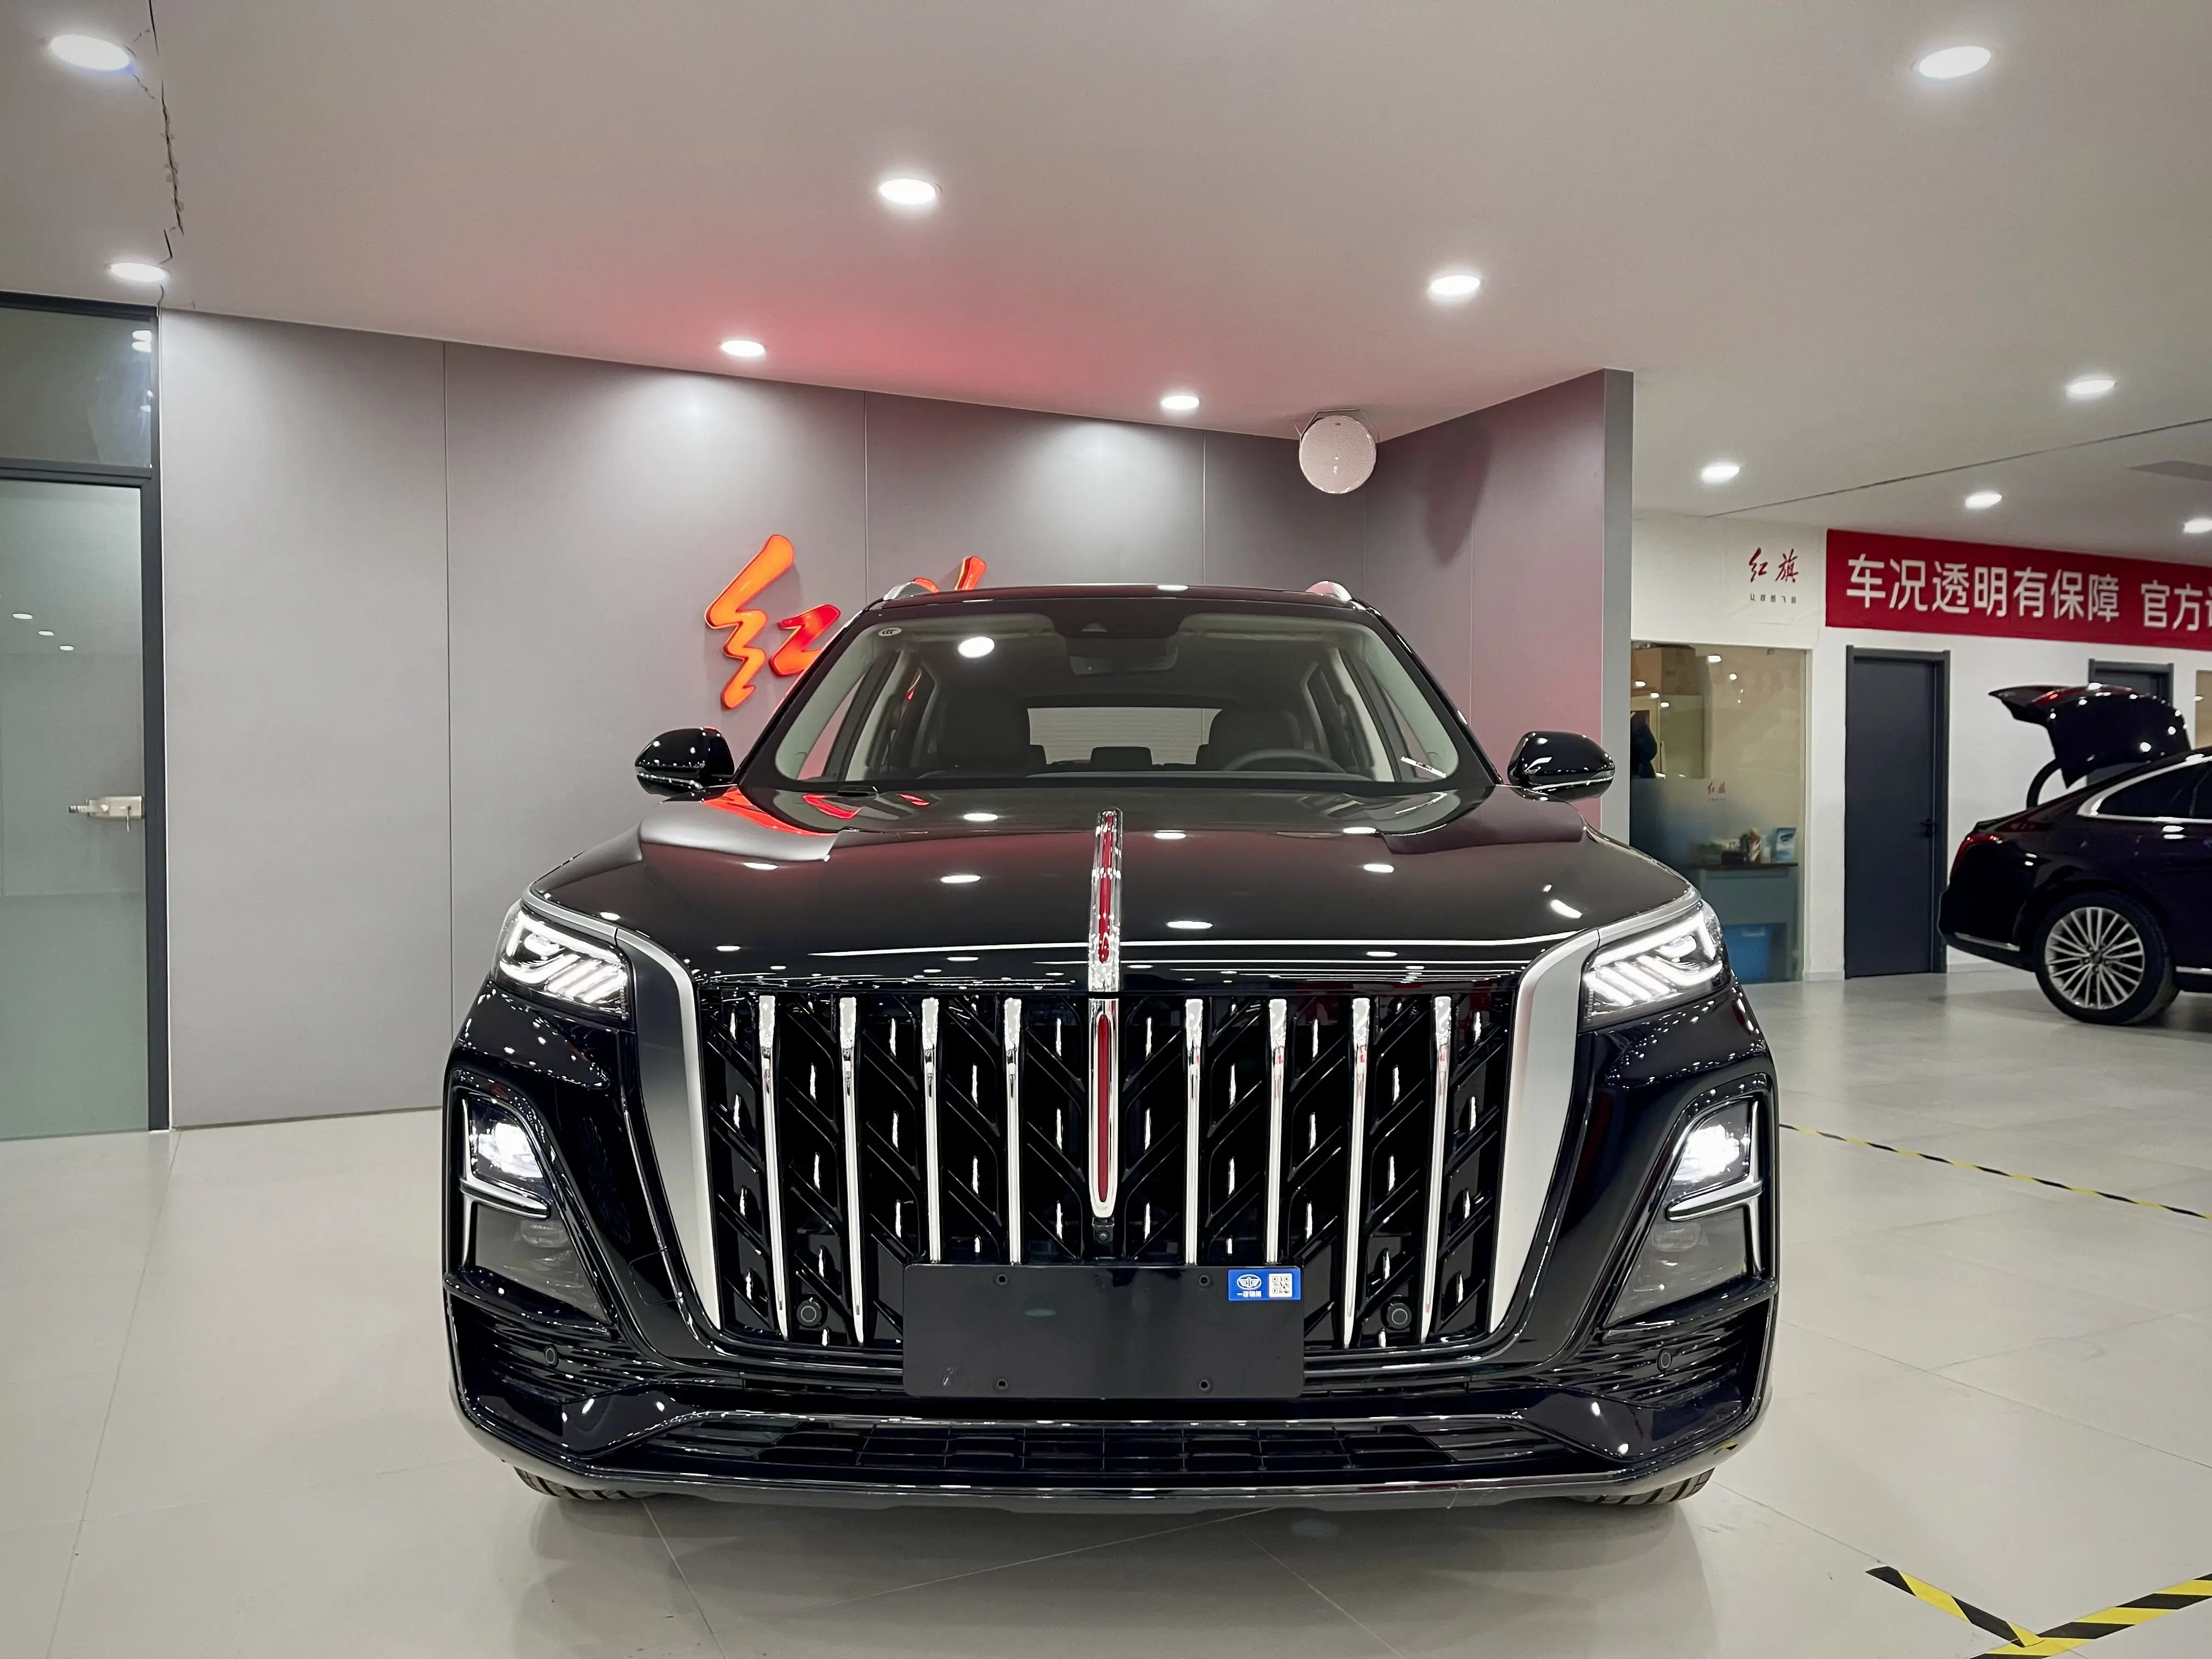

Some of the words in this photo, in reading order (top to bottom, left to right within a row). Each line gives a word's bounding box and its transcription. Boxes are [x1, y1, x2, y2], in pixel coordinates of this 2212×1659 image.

[1749, 547, 1799, 583] 红旗
[1847, 553, 2119, 623] 车况透明有保障
[2141, 579, 2212, 631] 官方
